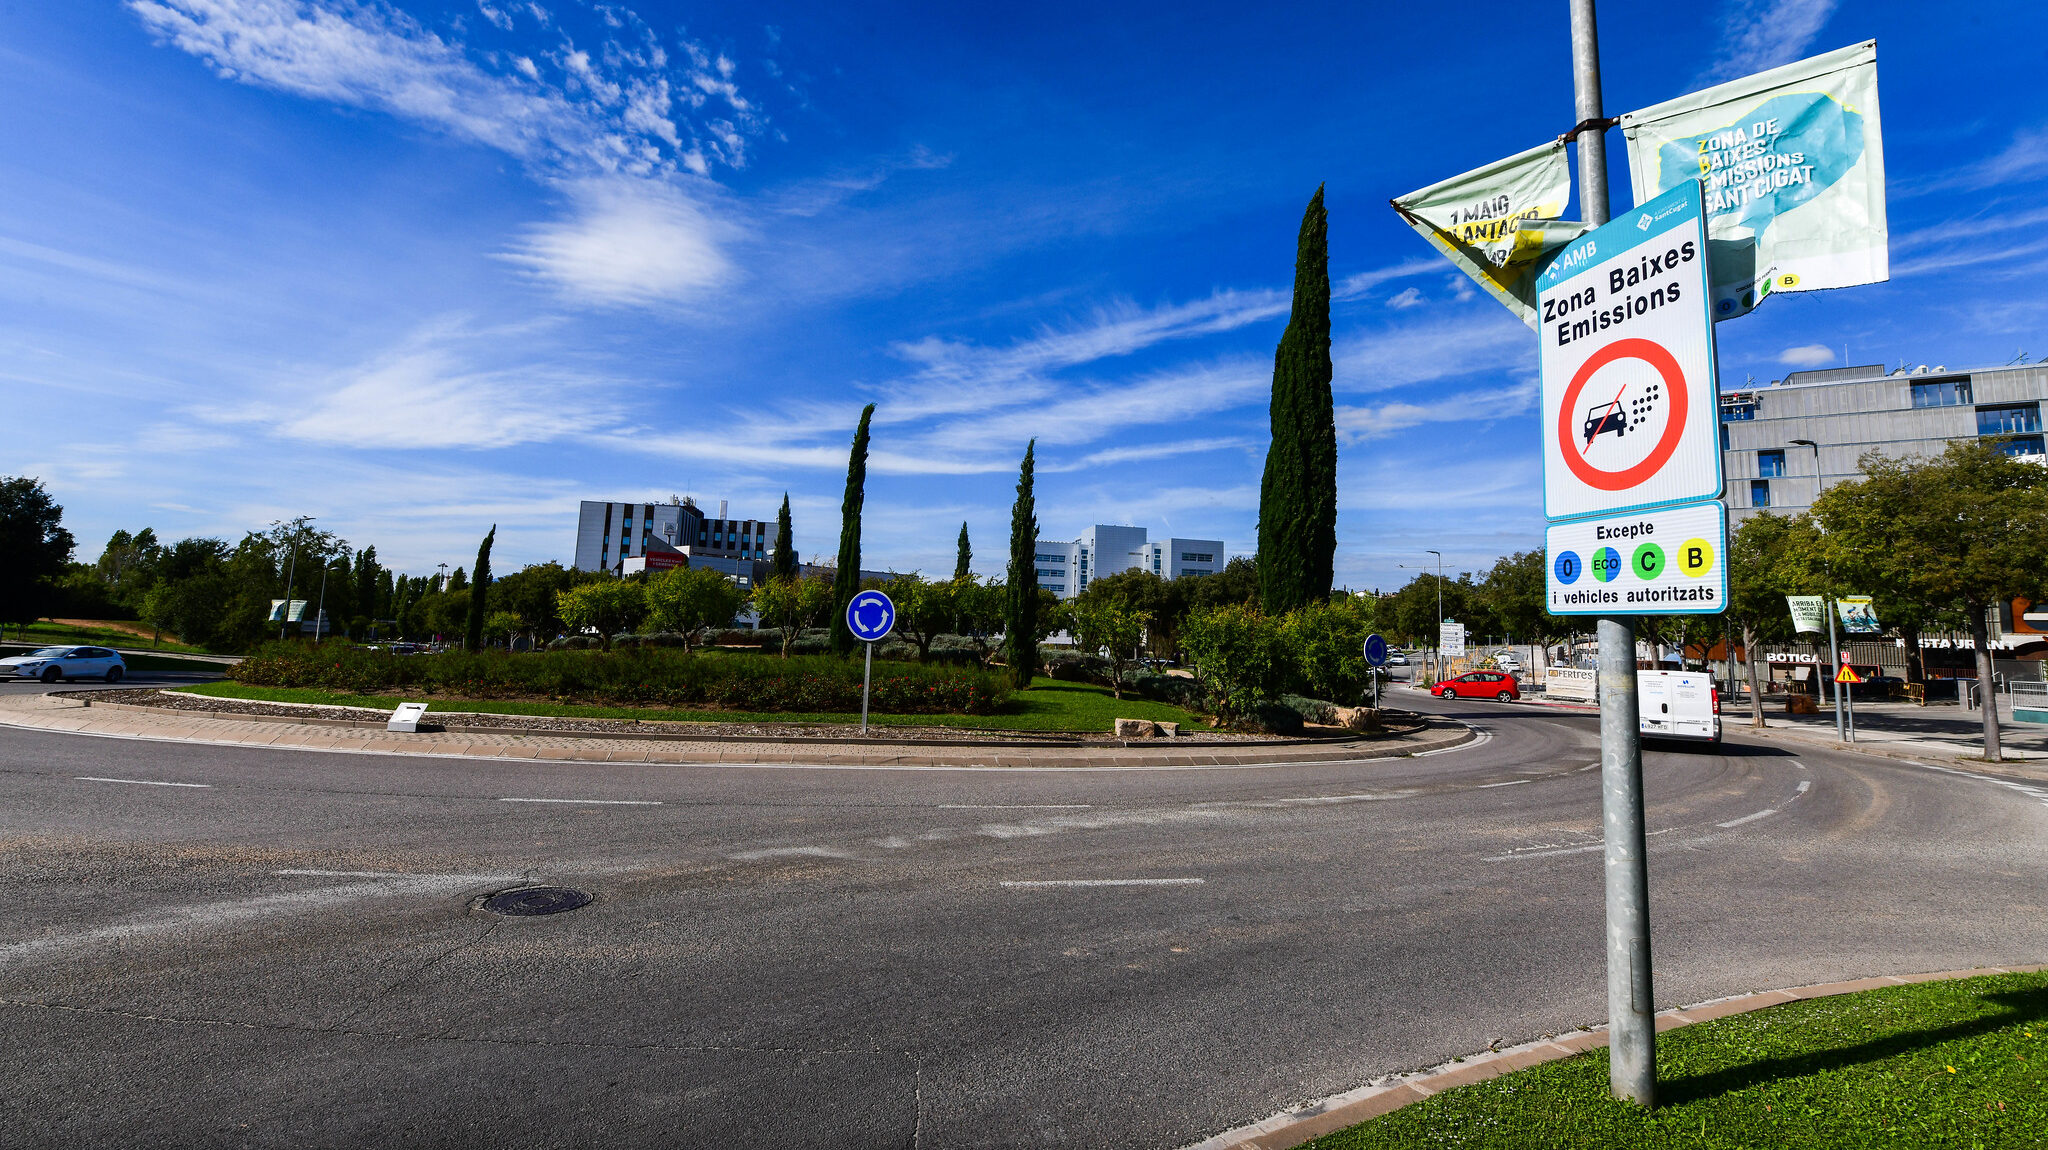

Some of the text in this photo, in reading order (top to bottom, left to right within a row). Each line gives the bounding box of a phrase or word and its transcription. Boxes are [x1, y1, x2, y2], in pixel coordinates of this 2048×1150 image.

[1697, 118, 1779, 154] ZONA DE
[1698, 139, 1767, 175] BAIXES
[1705, 165, 1814, 213] SANT CUGAT
[1450, 195, 1510, 225] 1 MAIG
[1564, 240, 1597, 270] AMB
[1543, 241, 1695, 323] Zona Baixes
[1784, 276, 1794, 285] B
[1558, 282, 1681, 346] Emissions
[1596, 522, 1654, 540] Excepte
[1593, 558, 1618, 570] ECO
[1641, 551, 1656, 571] C
[1687, 547, 1703, 568] B
[1553, 585, 1714, 604] i vehicles autoritzats
[1895, 638, 2015, 650] RSTAURNT
